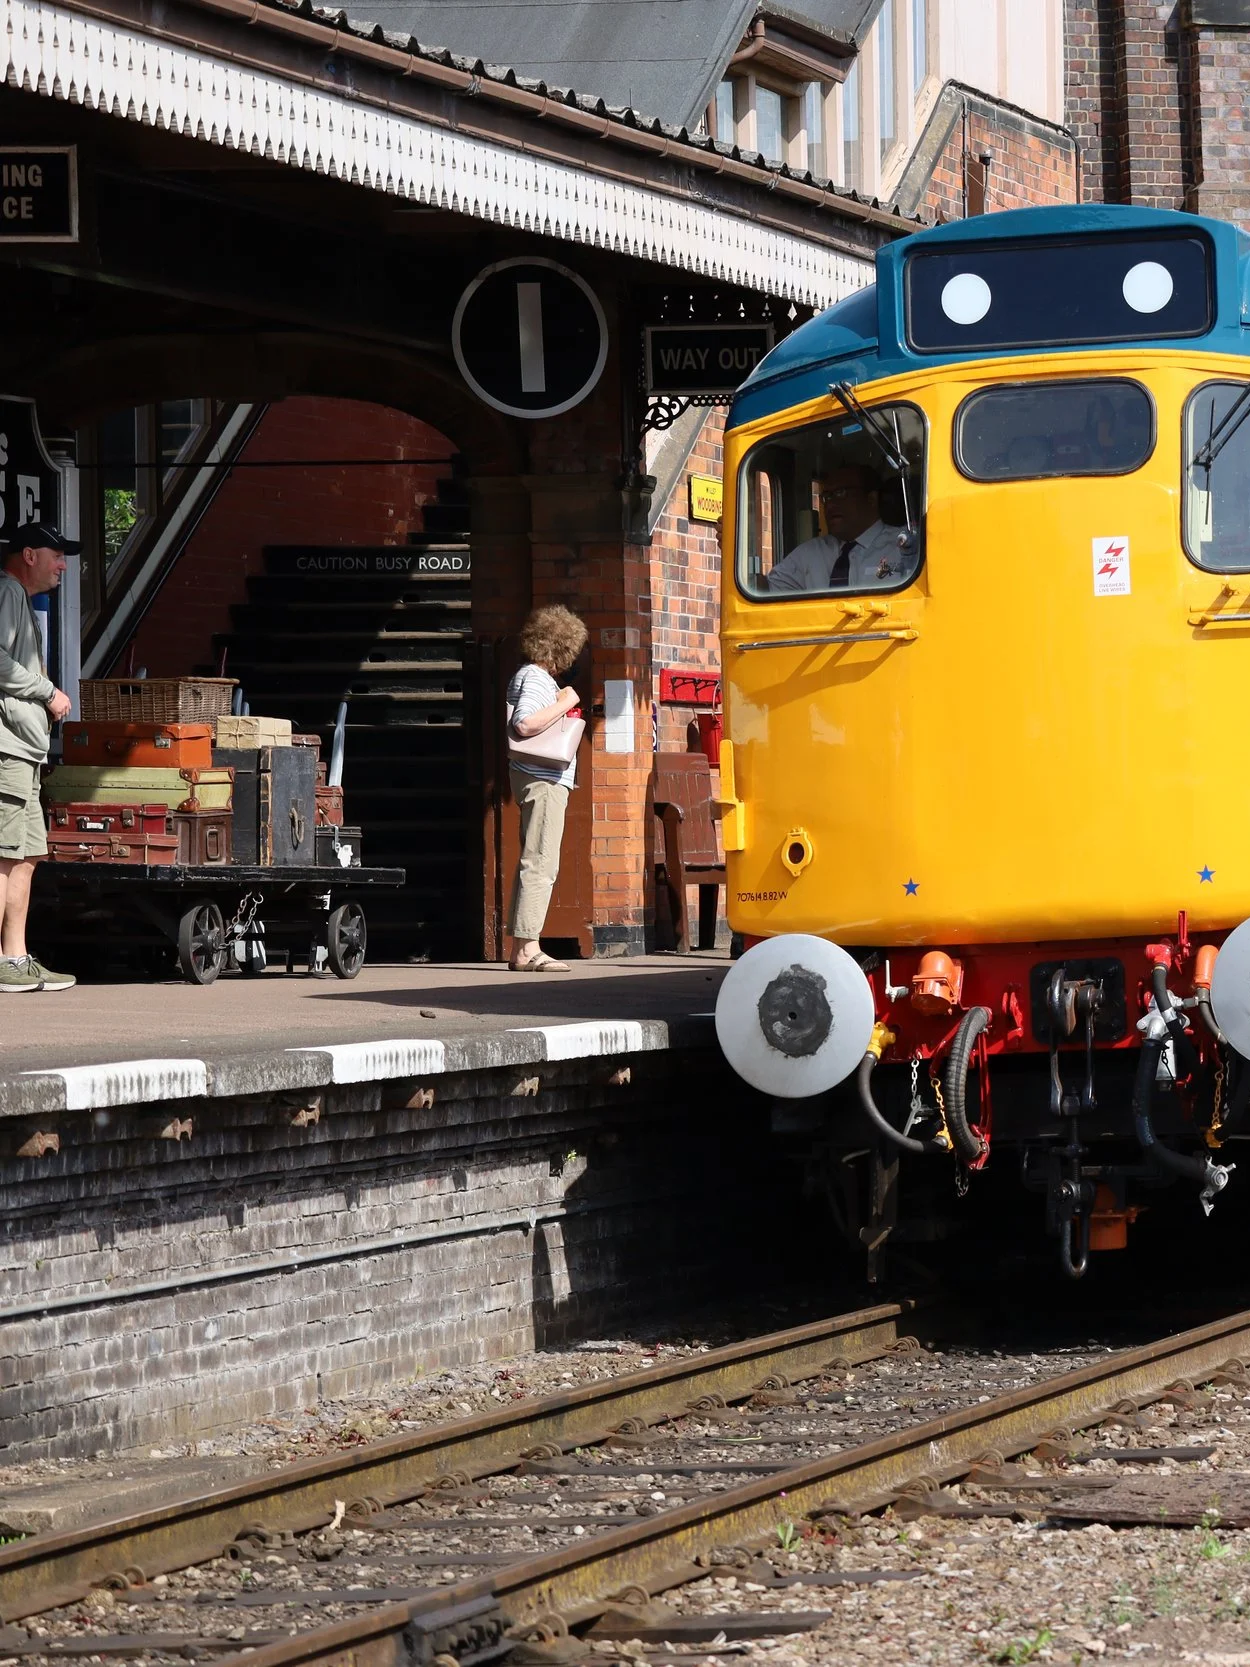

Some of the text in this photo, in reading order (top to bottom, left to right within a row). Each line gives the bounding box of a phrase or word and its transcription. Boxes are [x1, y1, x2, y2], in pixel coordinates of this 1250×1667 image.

[0, 164, 42, 187] ING
[2, 196, 34, 219] CE
[660, 347, 760, 370] WAY OUT
[296, 557, 368, 570] CAUTION
[375, 557, 412, 570] BUSY
[418, 556, 463, 570] ROAD
[1098, 556, 1124, 564] DANGER
